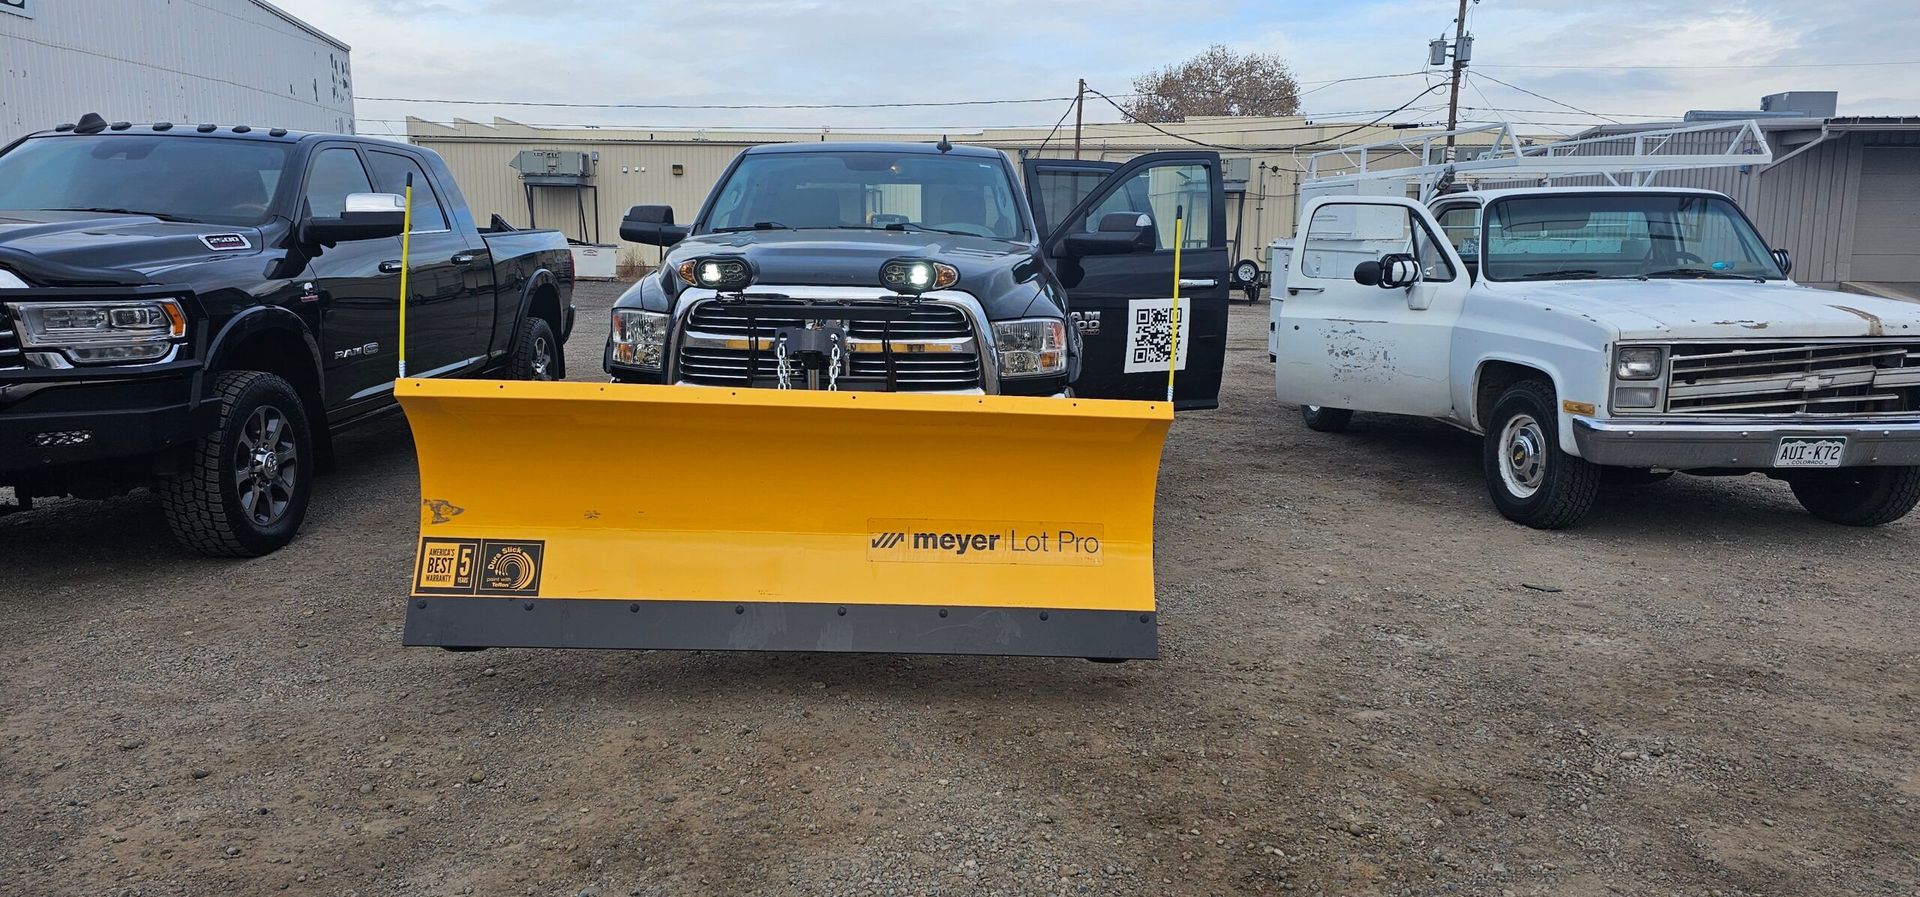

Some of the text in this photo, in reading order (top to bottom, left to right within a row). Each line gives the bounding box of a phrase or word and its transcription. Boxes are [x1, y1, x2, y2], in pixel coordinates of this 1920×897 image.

[1068, 311, 1101, 321] AM
[334, 346, 363, 360] RAM
[913, 529, 1099, 555] meyer Lot Pro
[429, 548, 456, 557] AMERICA'S
[487, 546, 523, 570] Dura Slick
[427, 557, 454, 574] BEST
[459, 548, 472, 577] 5
[425, 574, 451, 583] WARRANTY
[457, 576, 469, 584] YEARS
